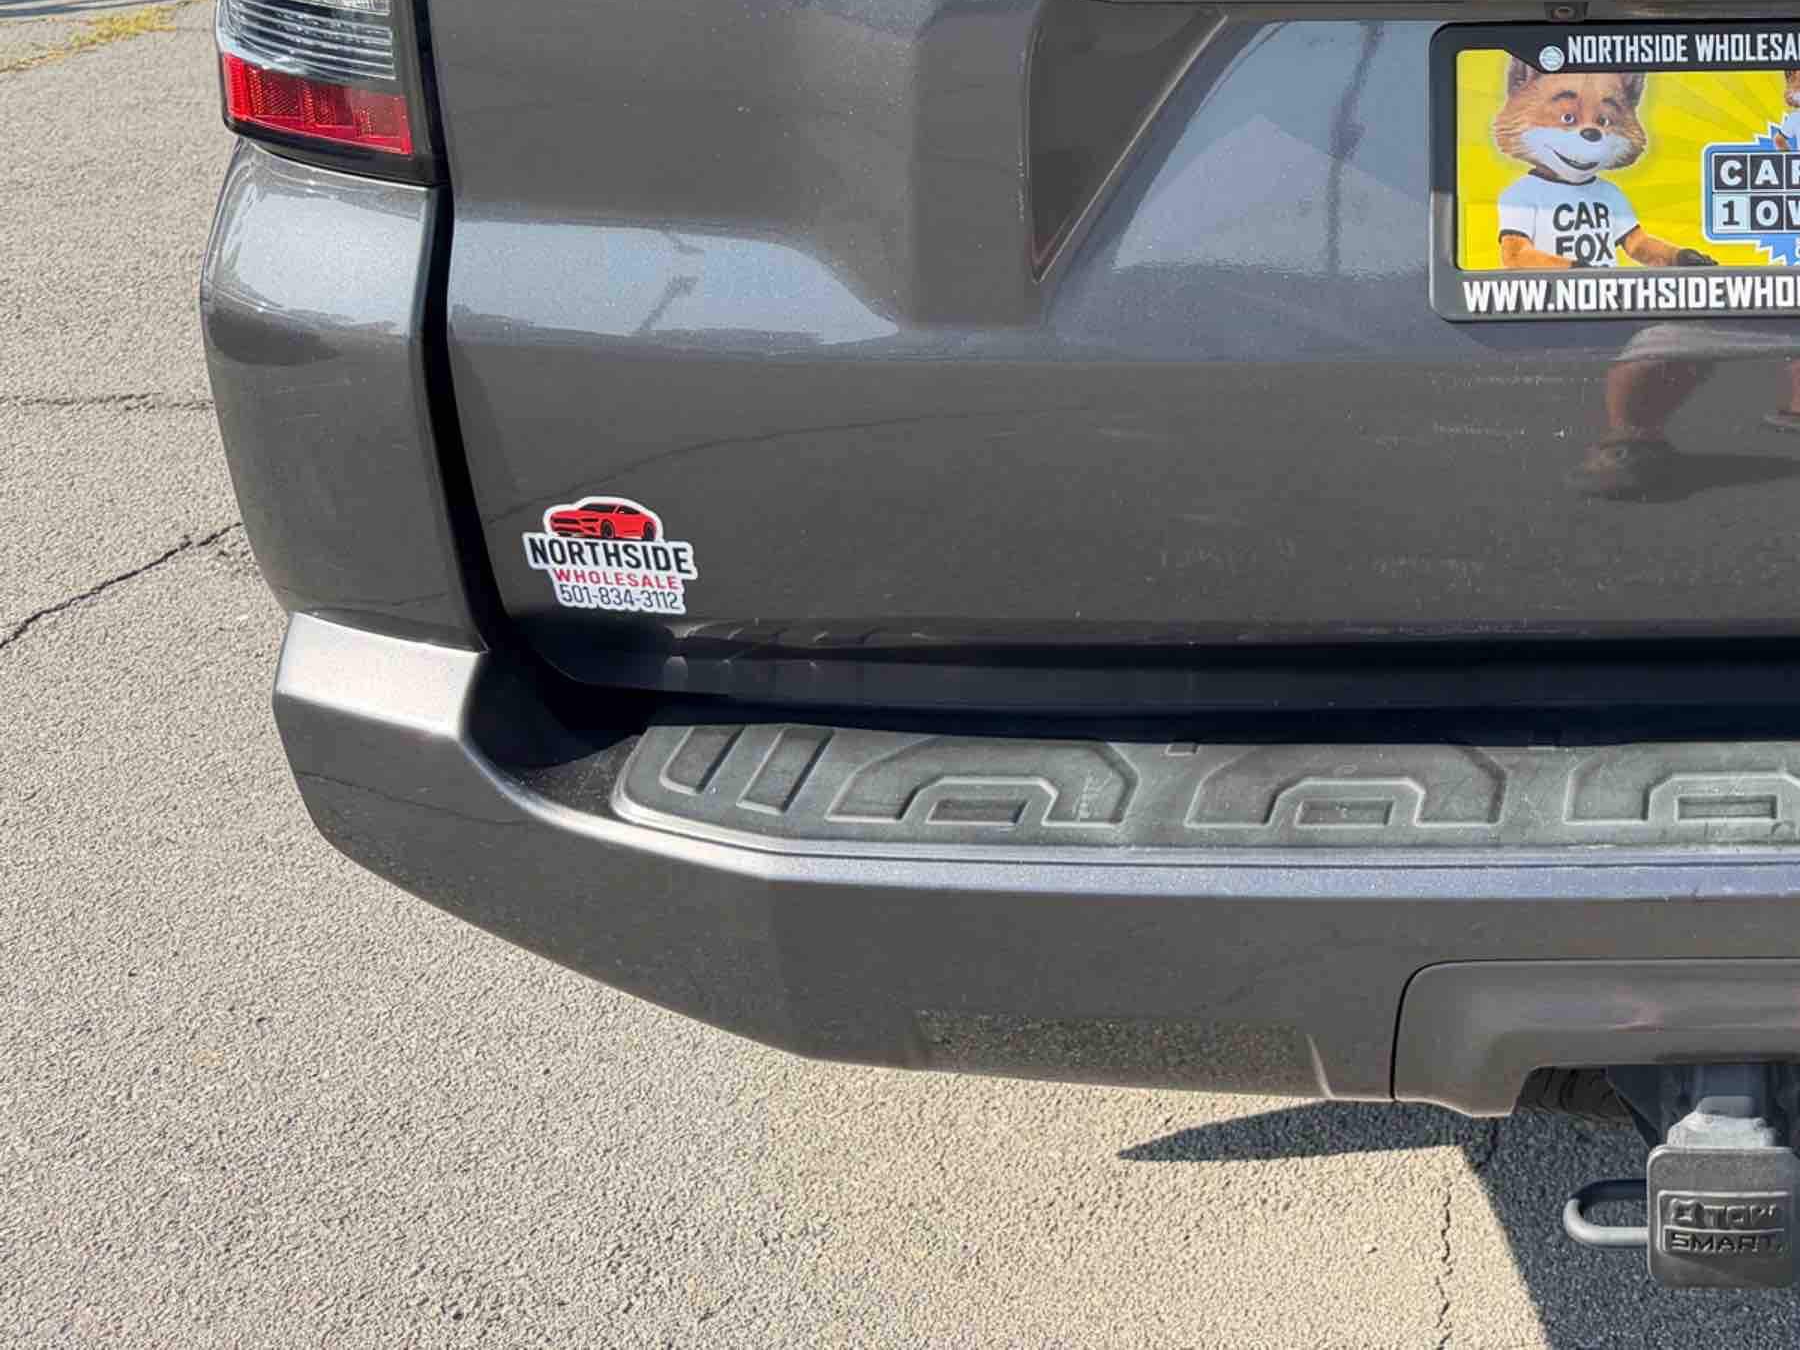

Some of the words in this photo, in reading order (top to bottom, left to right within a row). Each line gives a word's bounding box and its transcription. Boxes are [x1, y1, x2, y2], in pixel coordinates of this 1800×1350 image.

[1567, 34, 1689, 64] NORTHSIDE
[1552, 201, 1610, 232] CAR
[1555, 232, 1614, 263] FOX
[528, 536, 693, 574] NORTHSIDE
[553, 568, 681, 590] WHOLESALE
[558, 584, 682, 610] 501-834-3112
